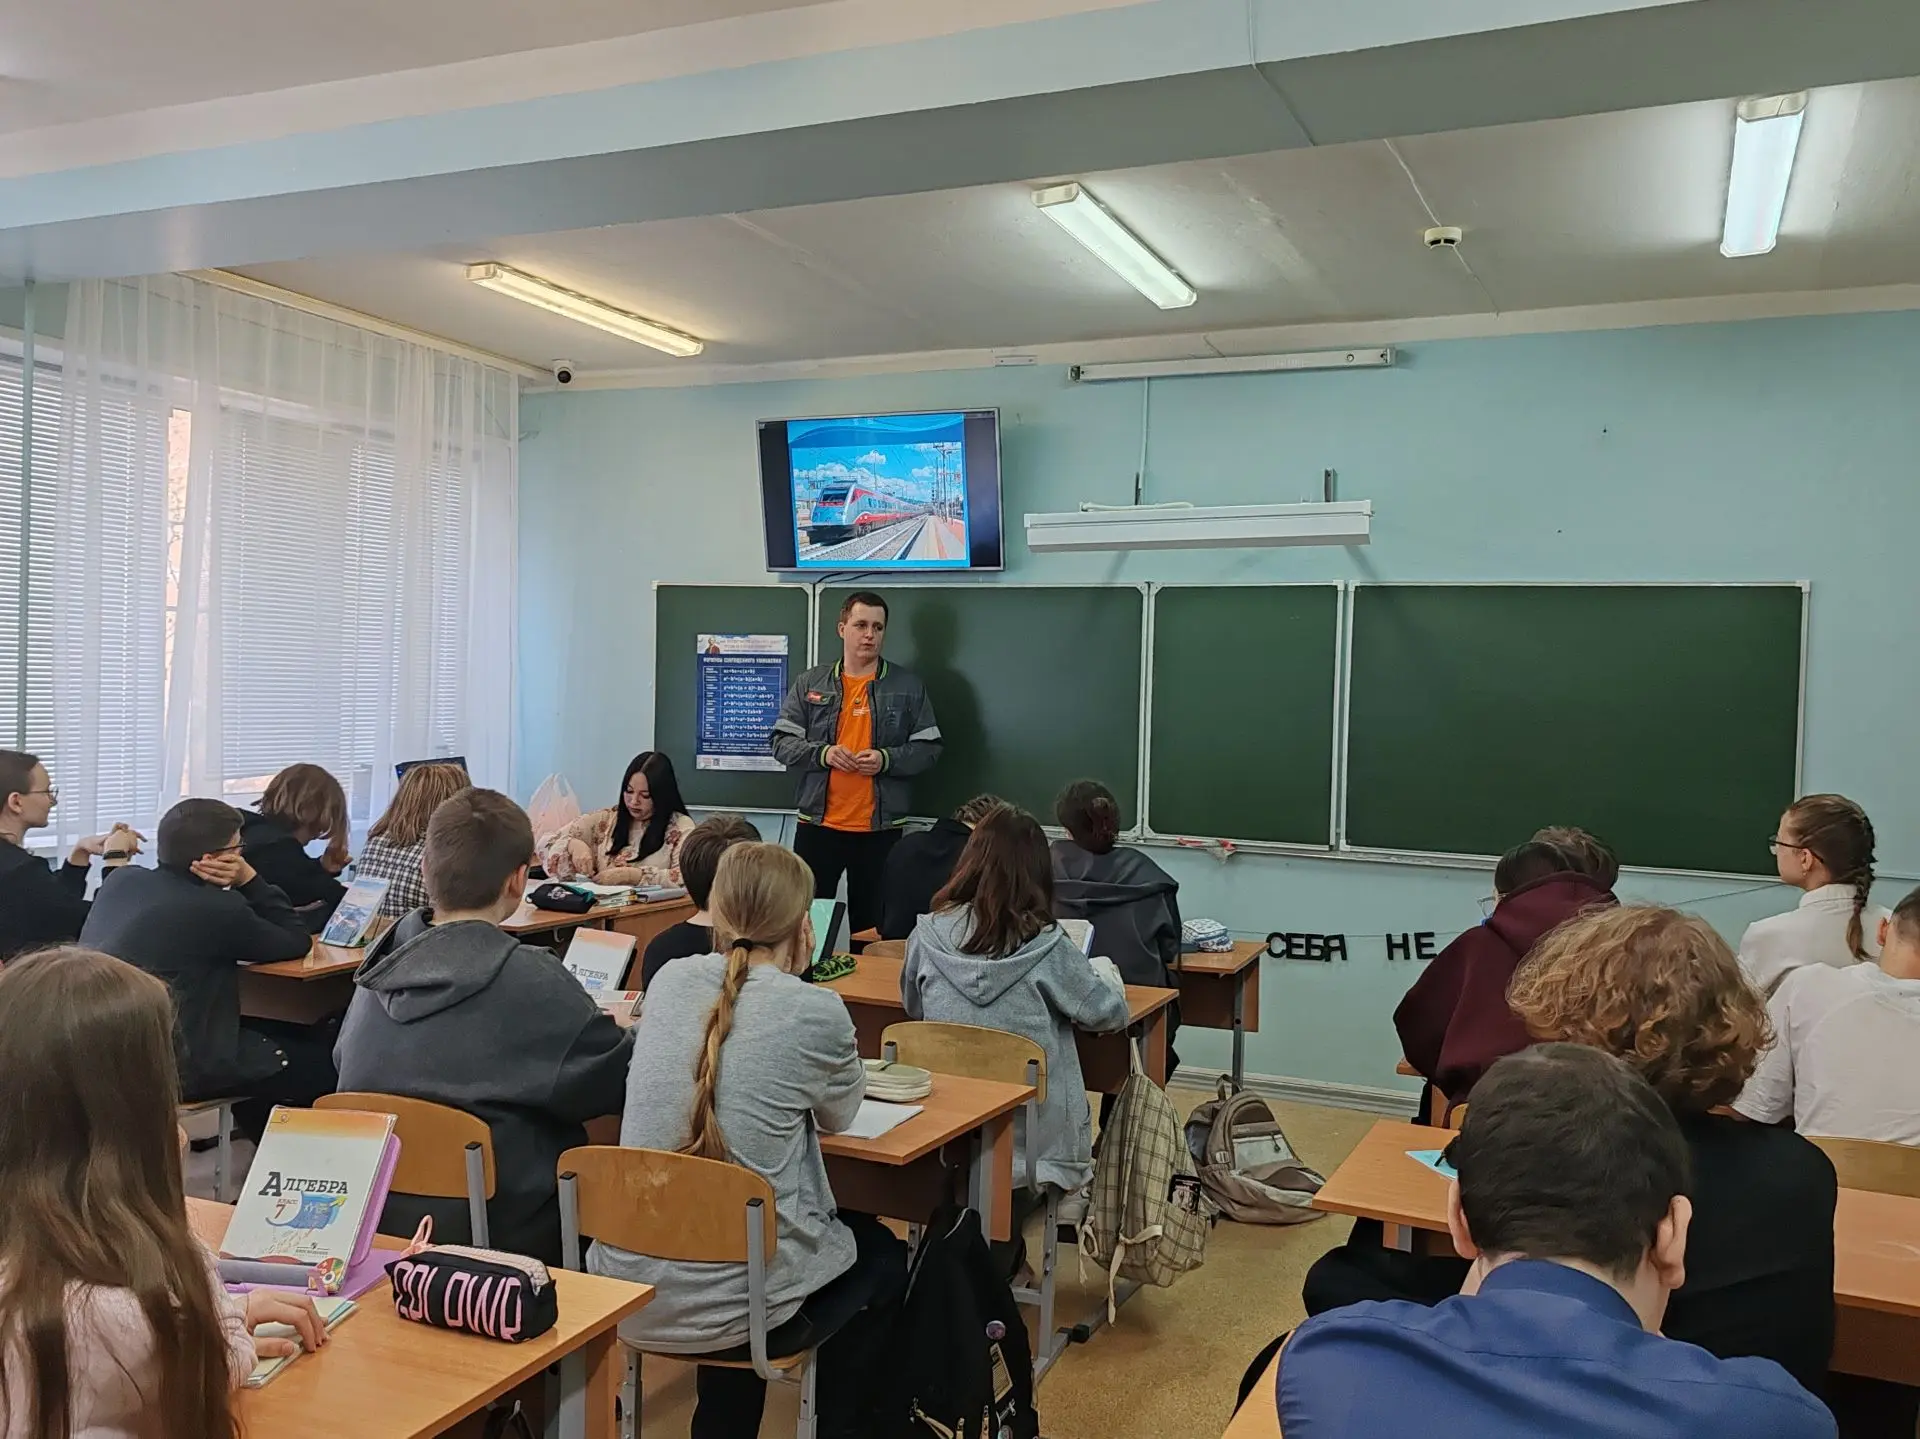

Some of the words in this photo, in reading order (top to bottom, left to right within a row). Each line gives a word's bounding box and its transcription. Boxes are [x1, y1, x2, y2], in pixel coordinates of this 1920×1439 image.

[1266, 932, 1348, 962] СЕБЯ
[1386, 931, 1438, 961] НЕ
[275, 1204, 286, 1219] 7
